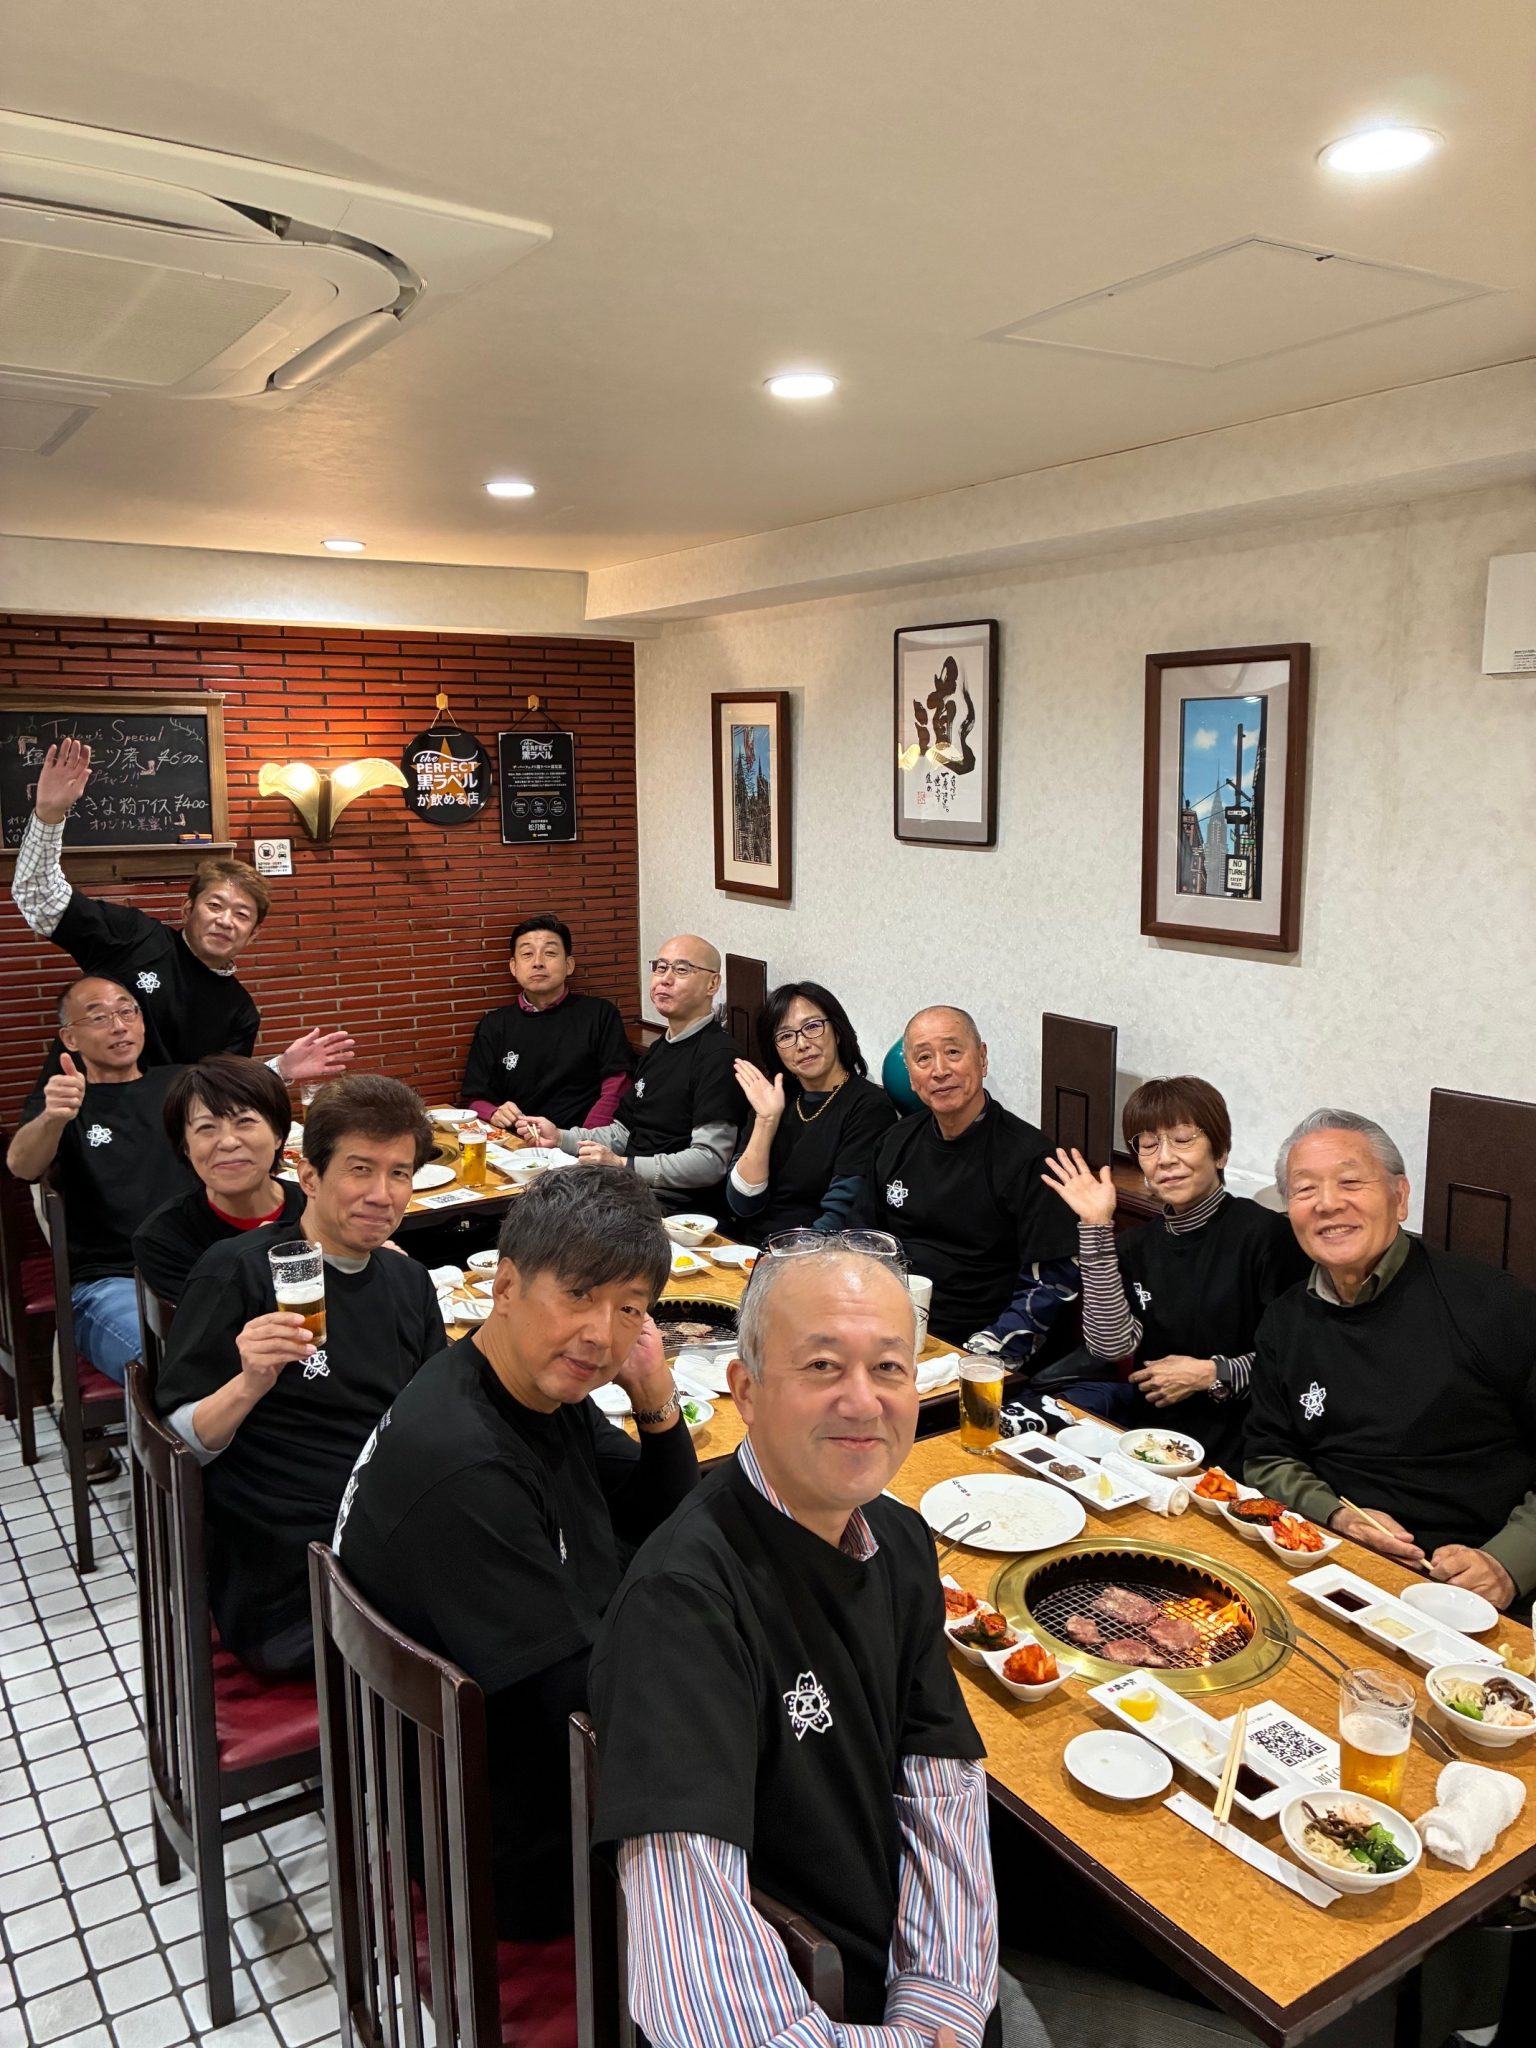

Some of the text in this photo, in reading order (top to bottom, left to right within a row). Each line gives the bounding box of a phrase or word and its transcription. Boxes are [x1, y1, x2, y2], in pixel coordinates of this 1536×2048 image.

[112, 719, 164, 746] Special
[420, 752, 440, 763] the
[416, 761, 478, 774] PERFECT
[416, 772, 479, 791] 黒ラベル
[416, 791, 480, 807] が飲める店
[1232, 860, 1243, 868] NO
[1228, 868, 1247, 876] TURNS
